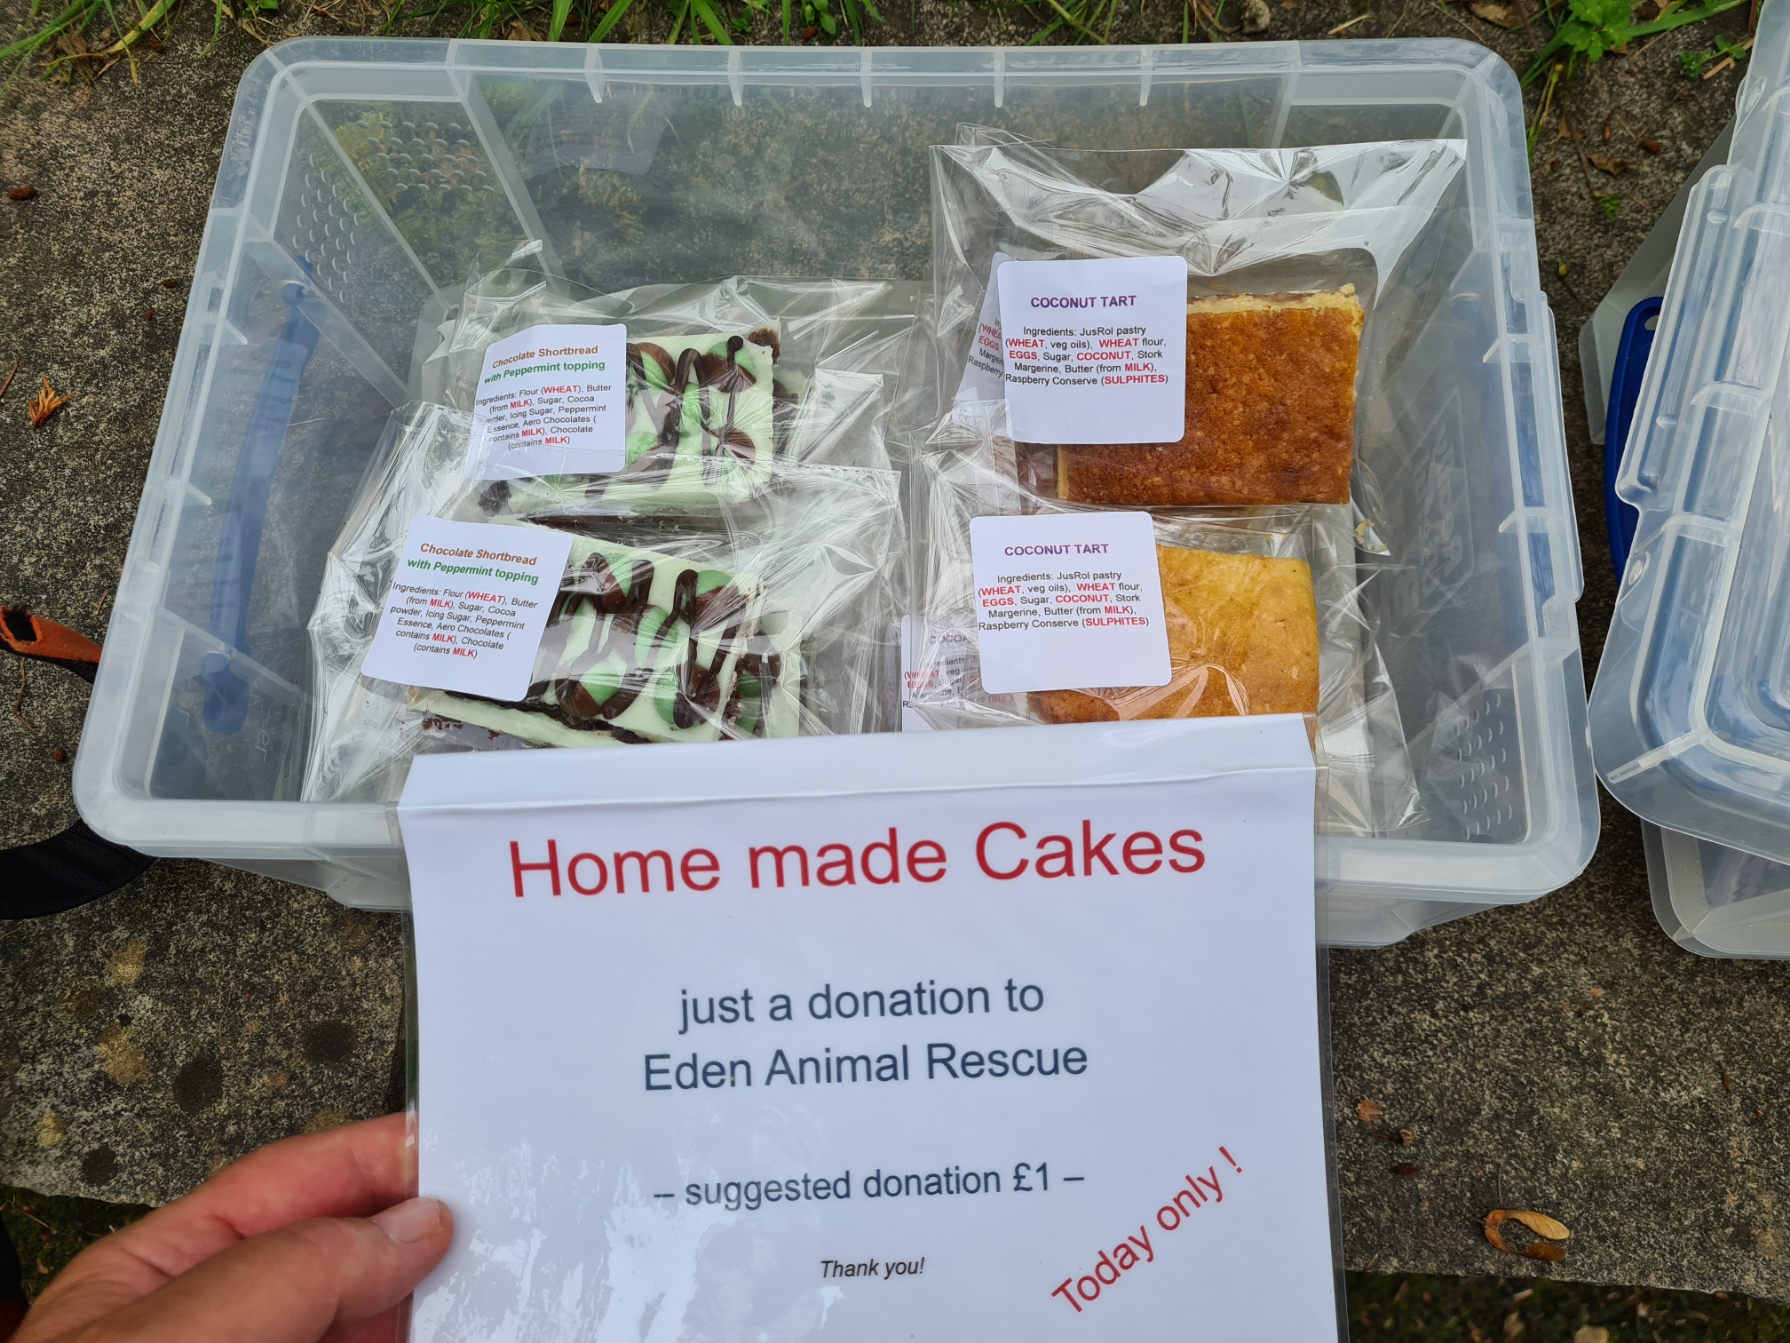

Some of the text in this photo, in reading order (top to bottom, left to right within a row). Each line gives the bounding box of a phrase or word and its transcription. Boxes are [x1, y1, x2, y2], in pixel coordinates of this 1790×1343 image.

[1031, 295, 1137, 308] COCONUT TART
[1023, 327, 1146, 338] Ingredients: JusRol pastry
[1006, 338, 1167, 350] (WHEAT, veg oils), WHEAT flour,
[492, 346, 598, 369] Chocolate Shortbread
[1009, 350, 1163, 362] EGGS, Sugar, COCONUT, Stork
[484, 361, 606, 384] with Peppermint topping
[1014, 363, 1157, 375] Margerine, Butter (from MILK),
[1006, 375, 1169, 386] Raspberry Conserve (SULPHITES)
[475, 384, 612, 407] Ingredients: Flour (WHEAT), Butter
[489, 404, 509, 415] (from
[510, 398, 535, 409] MILK),
[537, 397, 564, 406] Sugar,
[510, 411, 527, 420] Icing
[529, 408, 555, 417] Sugar,
[558, 405, 606, 414] Peppermint
[487, 422, 521, 434] Essence,
[523, 419, 541, 427] Aero
[543, 416, 590, 424] Chocolates
[522, 428, 548, 437] MILK),
[550, 426, 593, 434] Chocolate
[508, 436, 570, 451] (contains MILK)
[420, 543, 538, 566] Chocolate Shortbread
[1004, 544, 1109, 556] COCONUT TART
[407, 558, 539, 585] with Peppermint topping
[997, 571, 1122, 584] Ingredients: JusRol pastry
[392, 582, 538, 609] Ingredients: Flour (WHEAT), Butter
[978, 582, 1143, 598] (WHEAT, veg oils), WHEAT flour,
[406, 596, 517, 617] (from MILK), Sugar, Cocoa
[982, 594, 1140, 607] EGGS, Sugar, COCONUT, Stork
[390, 606, 525, 630] powder, Icing Sugar, Peppermint
[988, 605, 1137, 619] Margerine, Butter (from MILK),
[397, 617, 434, 630] Essence,
[436, 623, 456, 632] Aero
[457, 624, 505, 638] Chocolates
[978, 617, 1149, 632] Raspberry Conserve (SULPHITES)
[396, 630, 504, 650] contains MILK), Chocolate
[413, 643, 478, 659] (contains MILK)
[509, 818, 1207, 898] Home made Cakes
[677, 978, 1045, 1035] just a donation to
[644, 1043, 1089, 1091] Eden Animal Rescue
[684, 1169, 851, 1211] suggested
[862, 1163, 1002, 1199] donation
[1012, 1161, 1051, 1192] £1
[1051, 1225, 1154, 1312] Today
[1157, 1166, 1223, 1231] only
[819, 1256, 926, 1281] Thank you!
